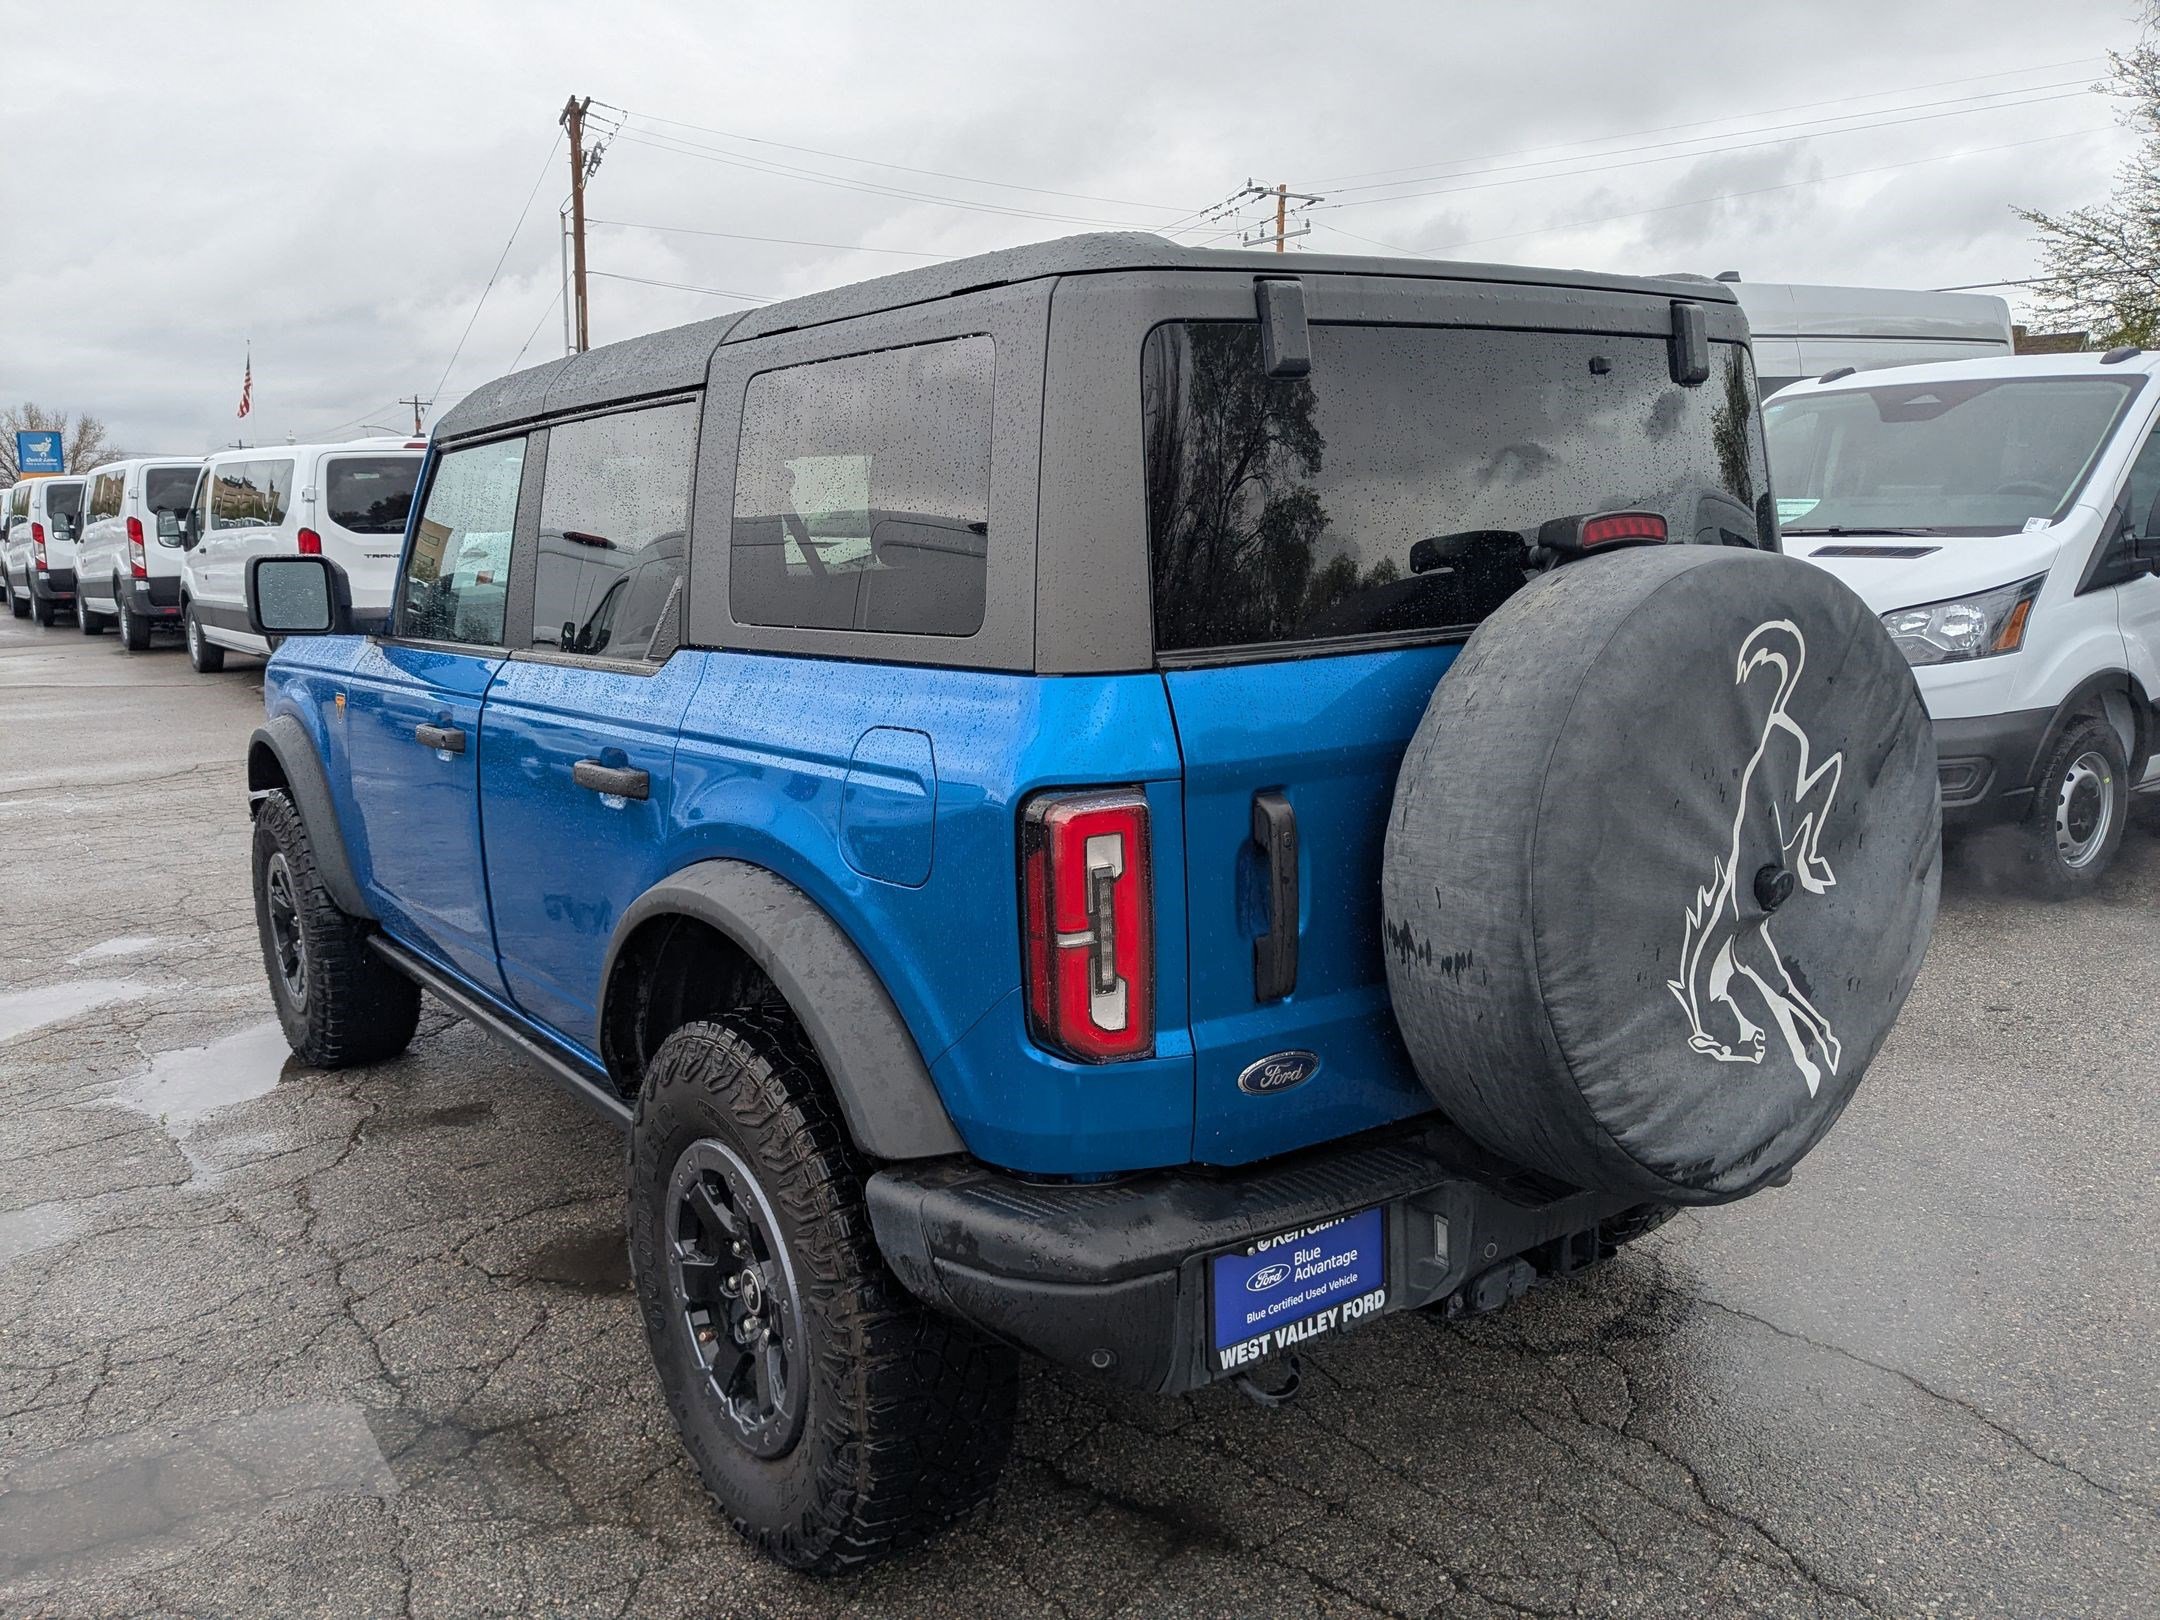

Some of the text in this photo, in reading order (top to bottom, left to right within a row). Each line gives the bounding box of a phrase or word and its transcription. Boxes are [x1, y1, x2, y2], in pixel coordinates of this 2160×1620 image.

[1260, 1061, 1303, 1088] Ford
[1294, 1246, 1321, 1266] Blue
[1294, 1249, 1358, 1282] Advantage
[1254, 1267, 1284, 1290] Ford
[1246, 1273, 1358, 1324] Blue Certified Used Vehicle
[1219, 1289, 1386, 1370] WEST VALLEY FORD
